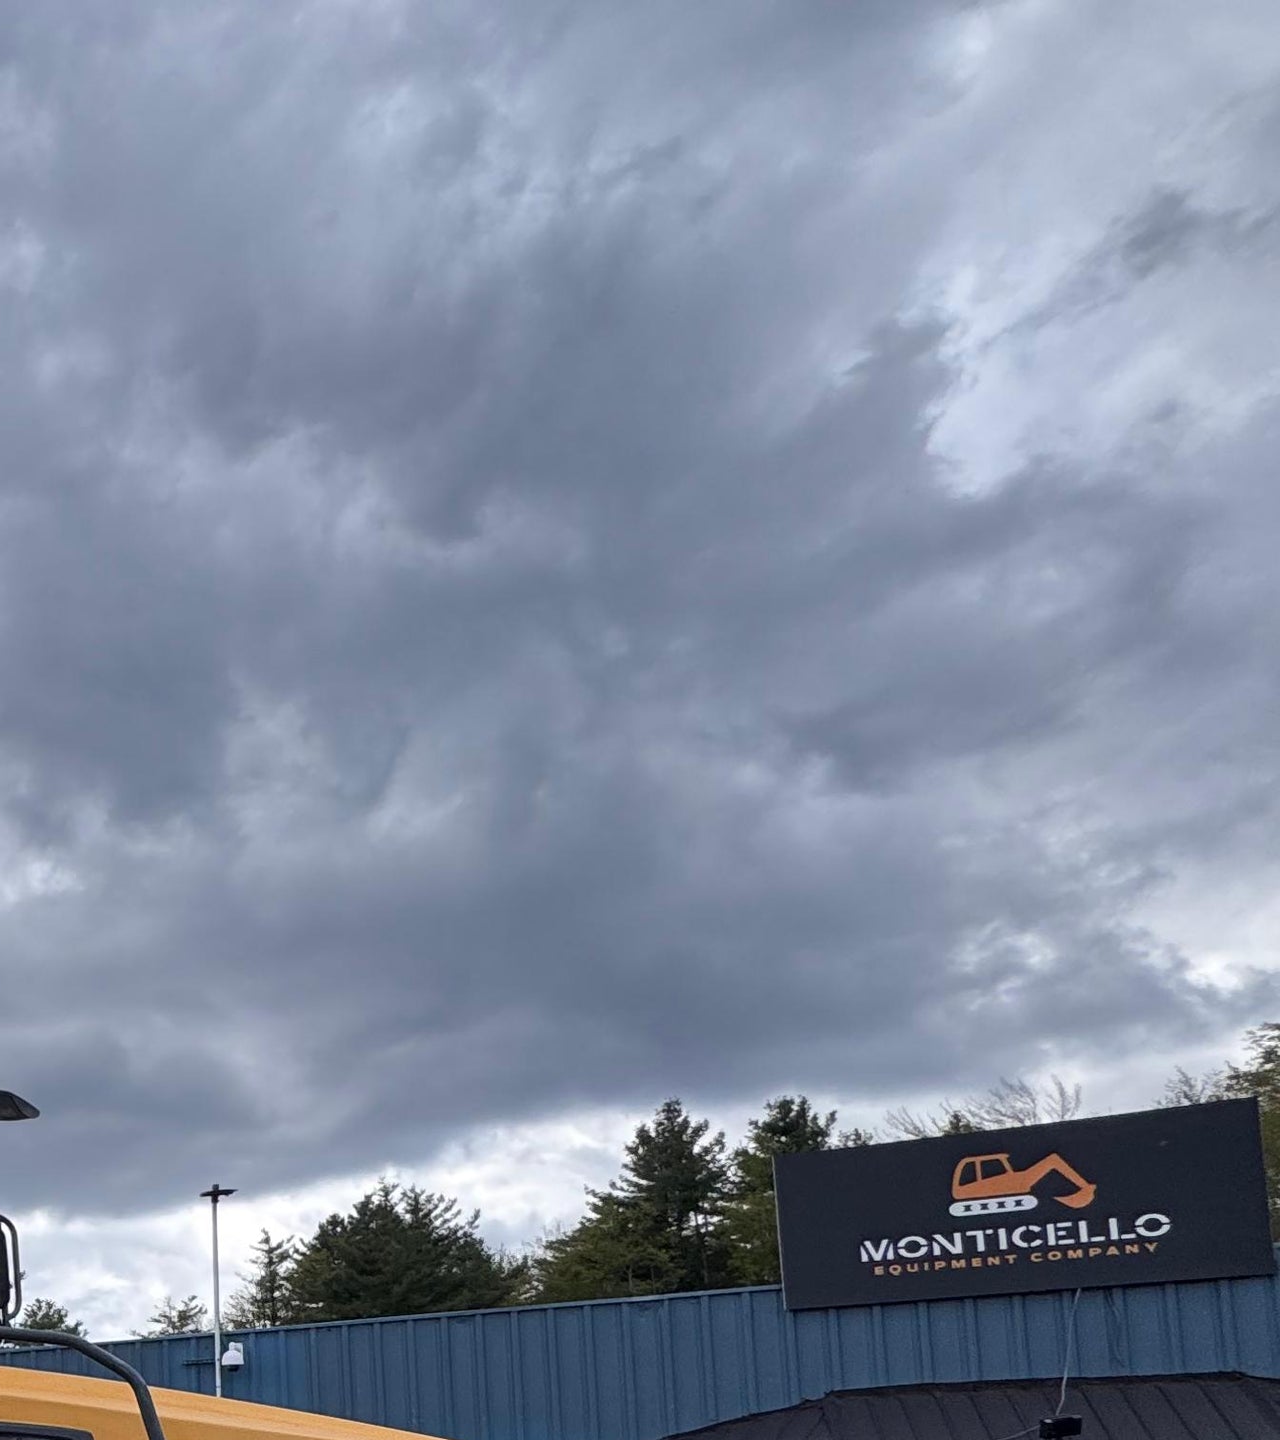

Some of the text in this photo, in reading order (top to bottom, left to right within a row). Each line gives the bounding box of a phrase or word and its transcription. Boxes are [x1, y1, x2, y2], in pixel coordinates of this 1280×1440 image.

[861, 1213, 1171, 1263] MONTICELLO
[873, 1241, 1160, 1277] EQUIPMENT COMPANY
